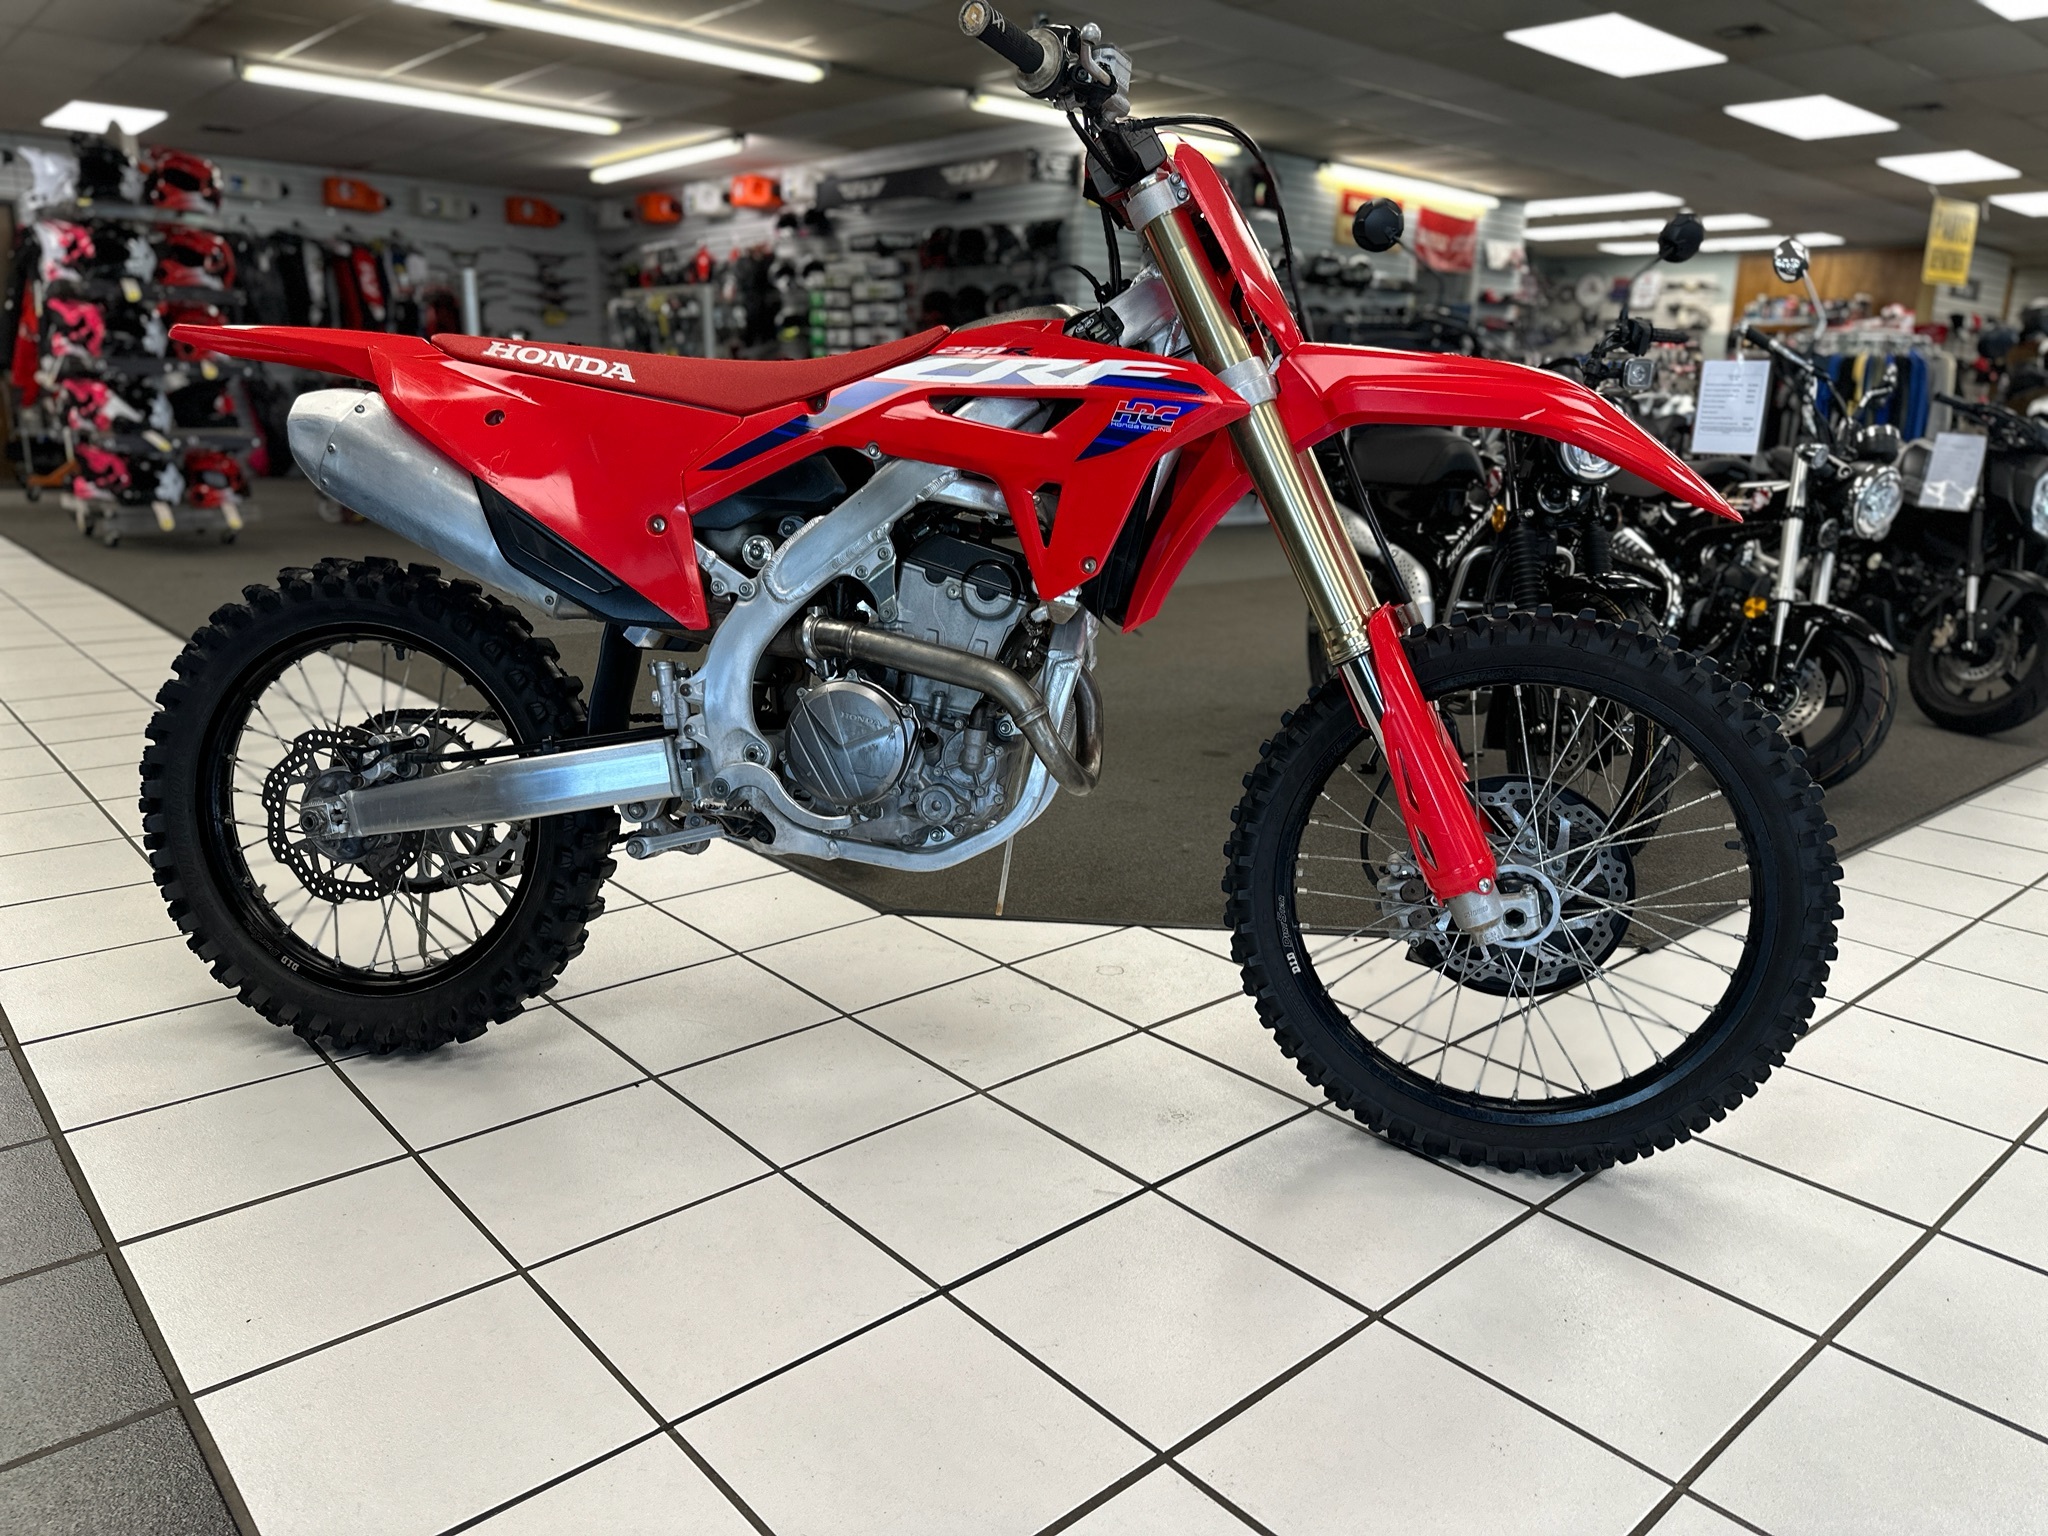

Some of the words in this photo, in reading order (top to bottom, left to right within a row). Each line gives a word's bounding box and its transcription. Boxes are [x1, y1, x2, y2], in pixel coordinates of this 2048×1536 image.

[482, 341, 636, 383] HONDA
[874, 356, 1188, 386] CRF
[1111, 400, 1181, 428] HRC
[840, 711, 883, 729] HONDA
